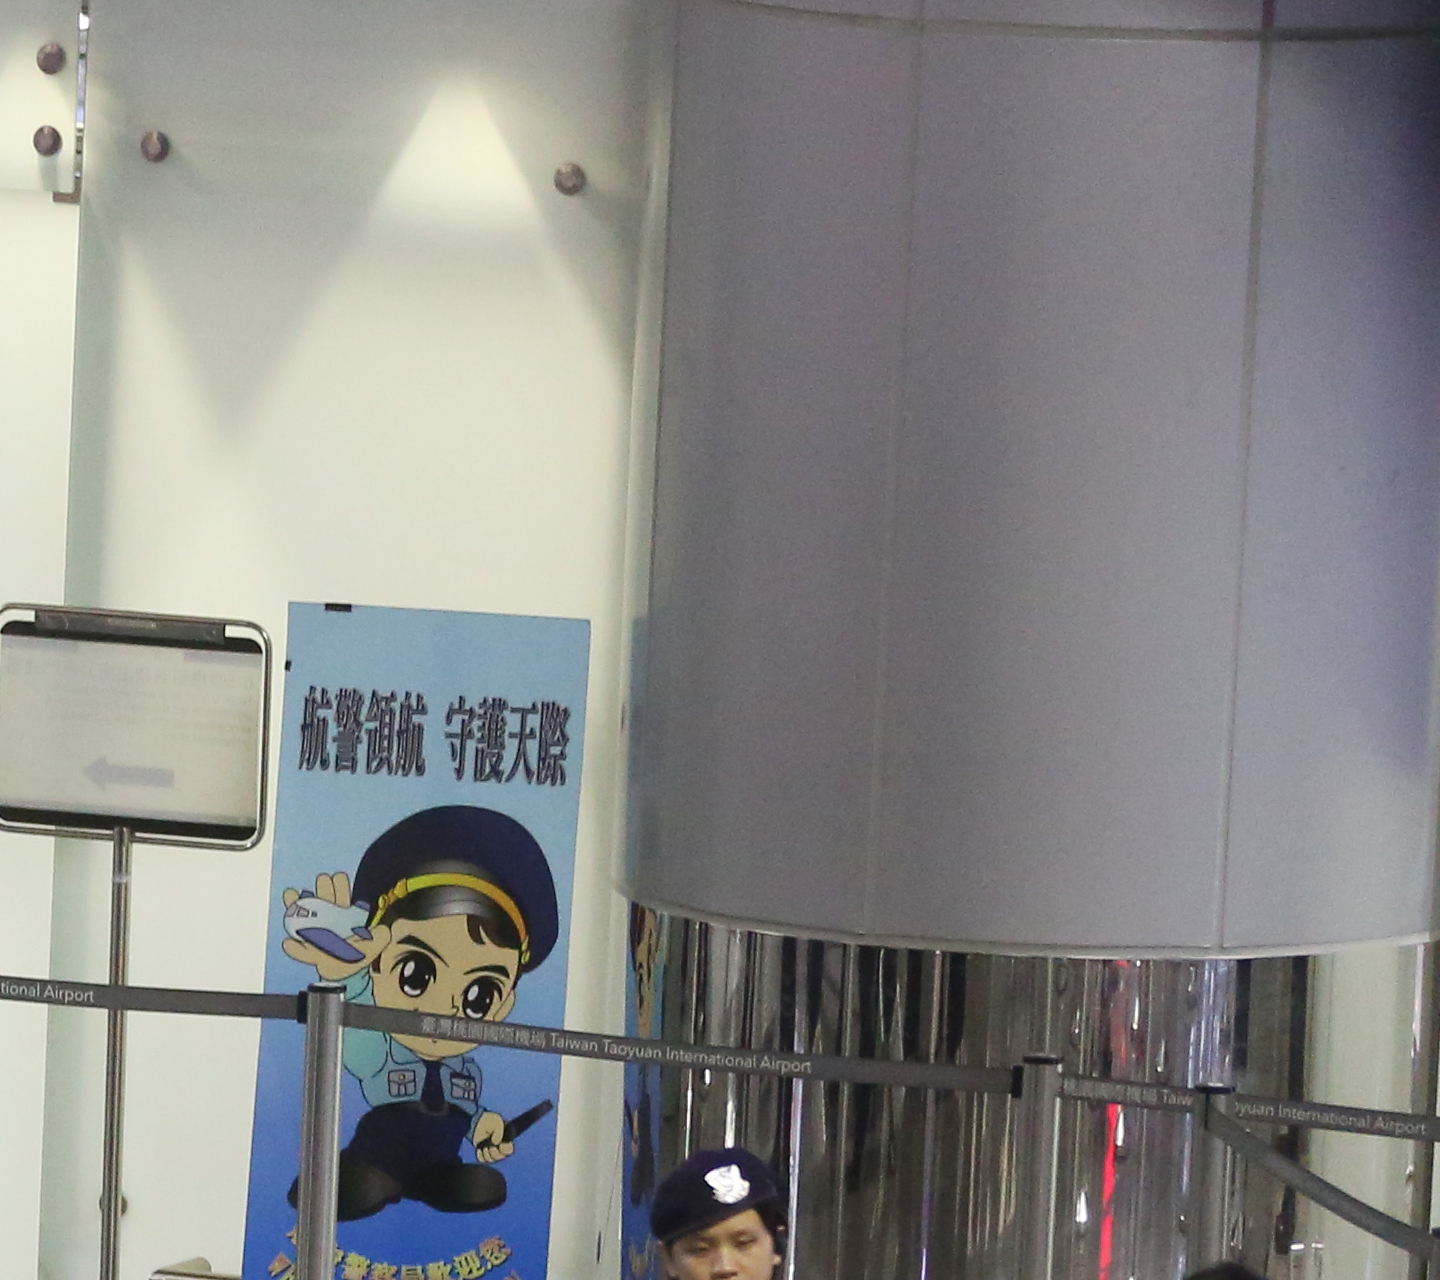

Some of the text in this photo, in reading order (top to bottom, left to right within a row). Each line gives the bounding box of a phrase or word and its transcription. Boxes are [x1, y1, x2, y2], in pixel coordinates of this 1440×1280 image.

[298, 684, 428, 776] 航警領航
[445, 695, 570, 786] 守護天際
[44, 985, 95, 1003] Airport
[550, 1032, 598, 1052] Taiwan
[602, 1038, 662, 1061] Taoyuan
[666, 1046, 756, 1068] International
[760, 1056, 812, 1074] Airport
[1278, 1103, 1371, 1129] International
[1374, 1117, 1428, 1136] Airport
